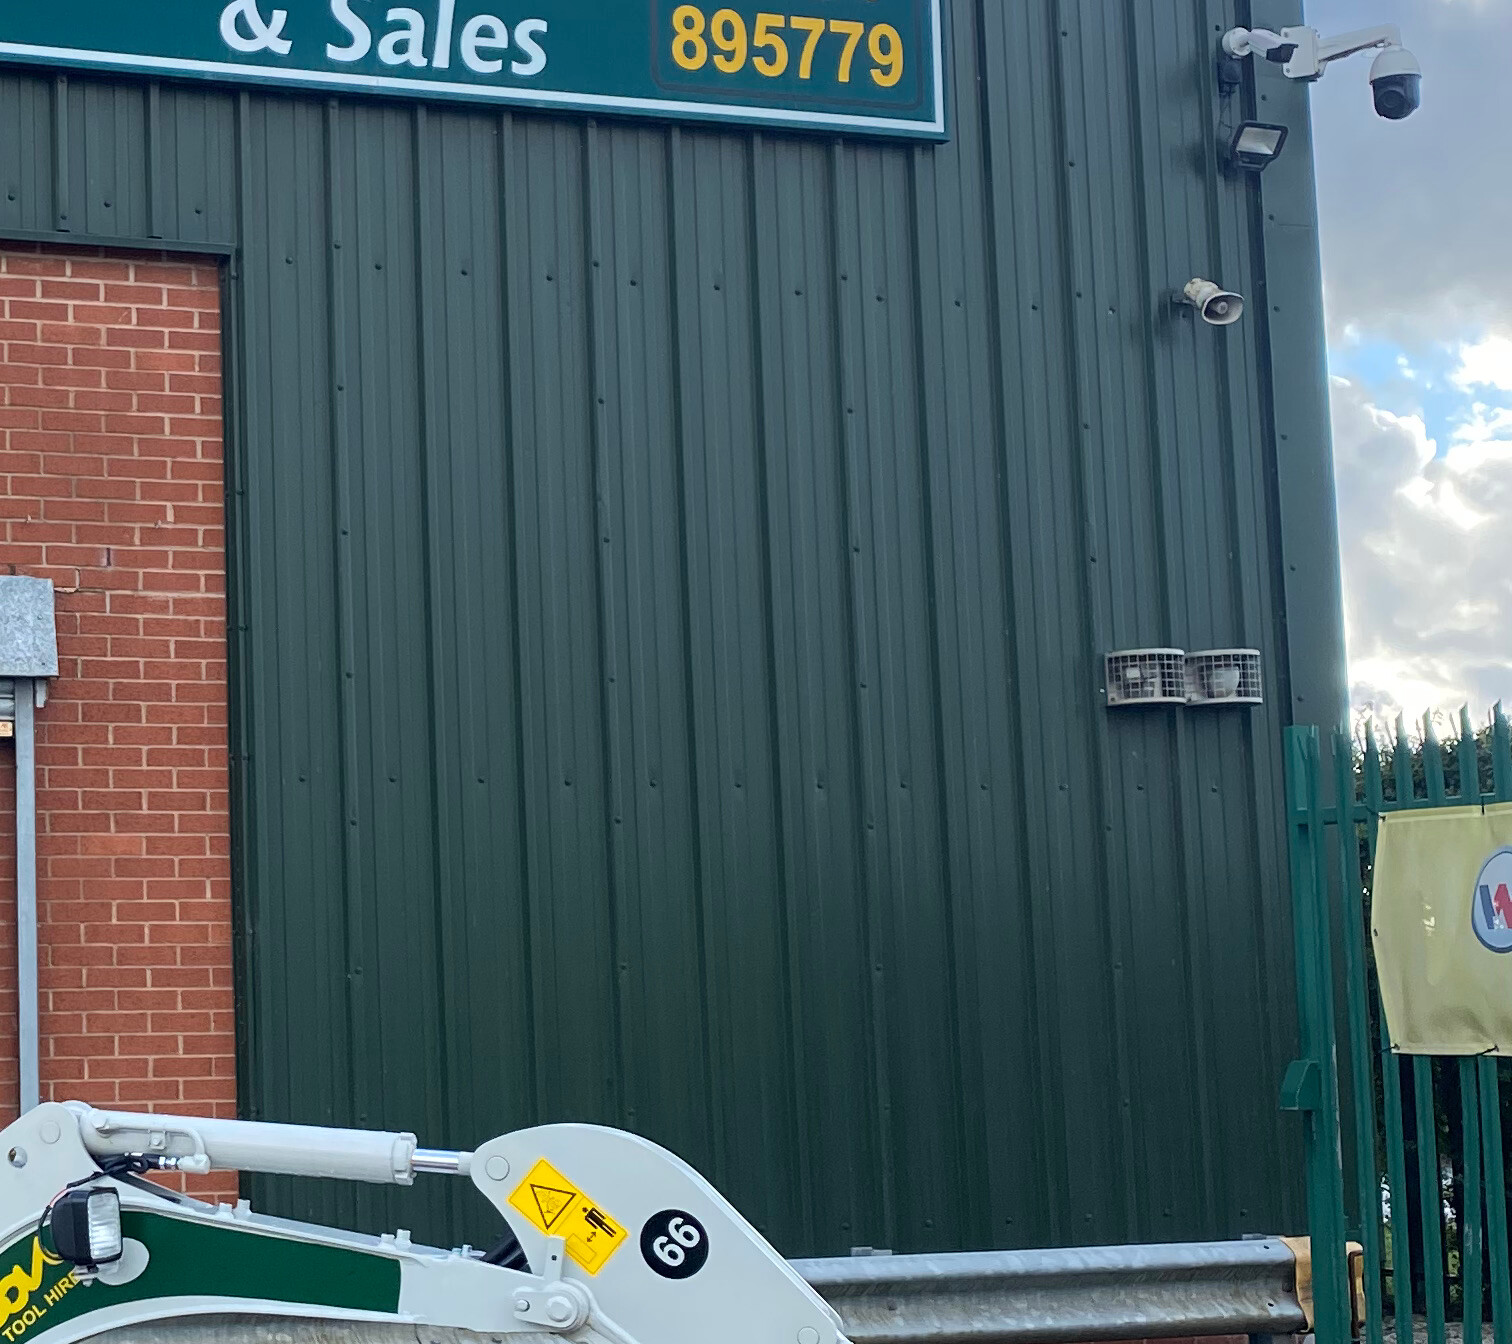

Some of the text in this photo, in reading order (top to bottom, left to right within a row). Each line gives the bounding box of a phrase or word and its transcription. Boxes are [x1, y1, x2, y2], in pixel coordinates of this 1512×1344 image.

[670, 4, 905, 88] 895779
[652, 1215, 701, 1267] 66
[1, 1304, 48, 1342] TOOL
